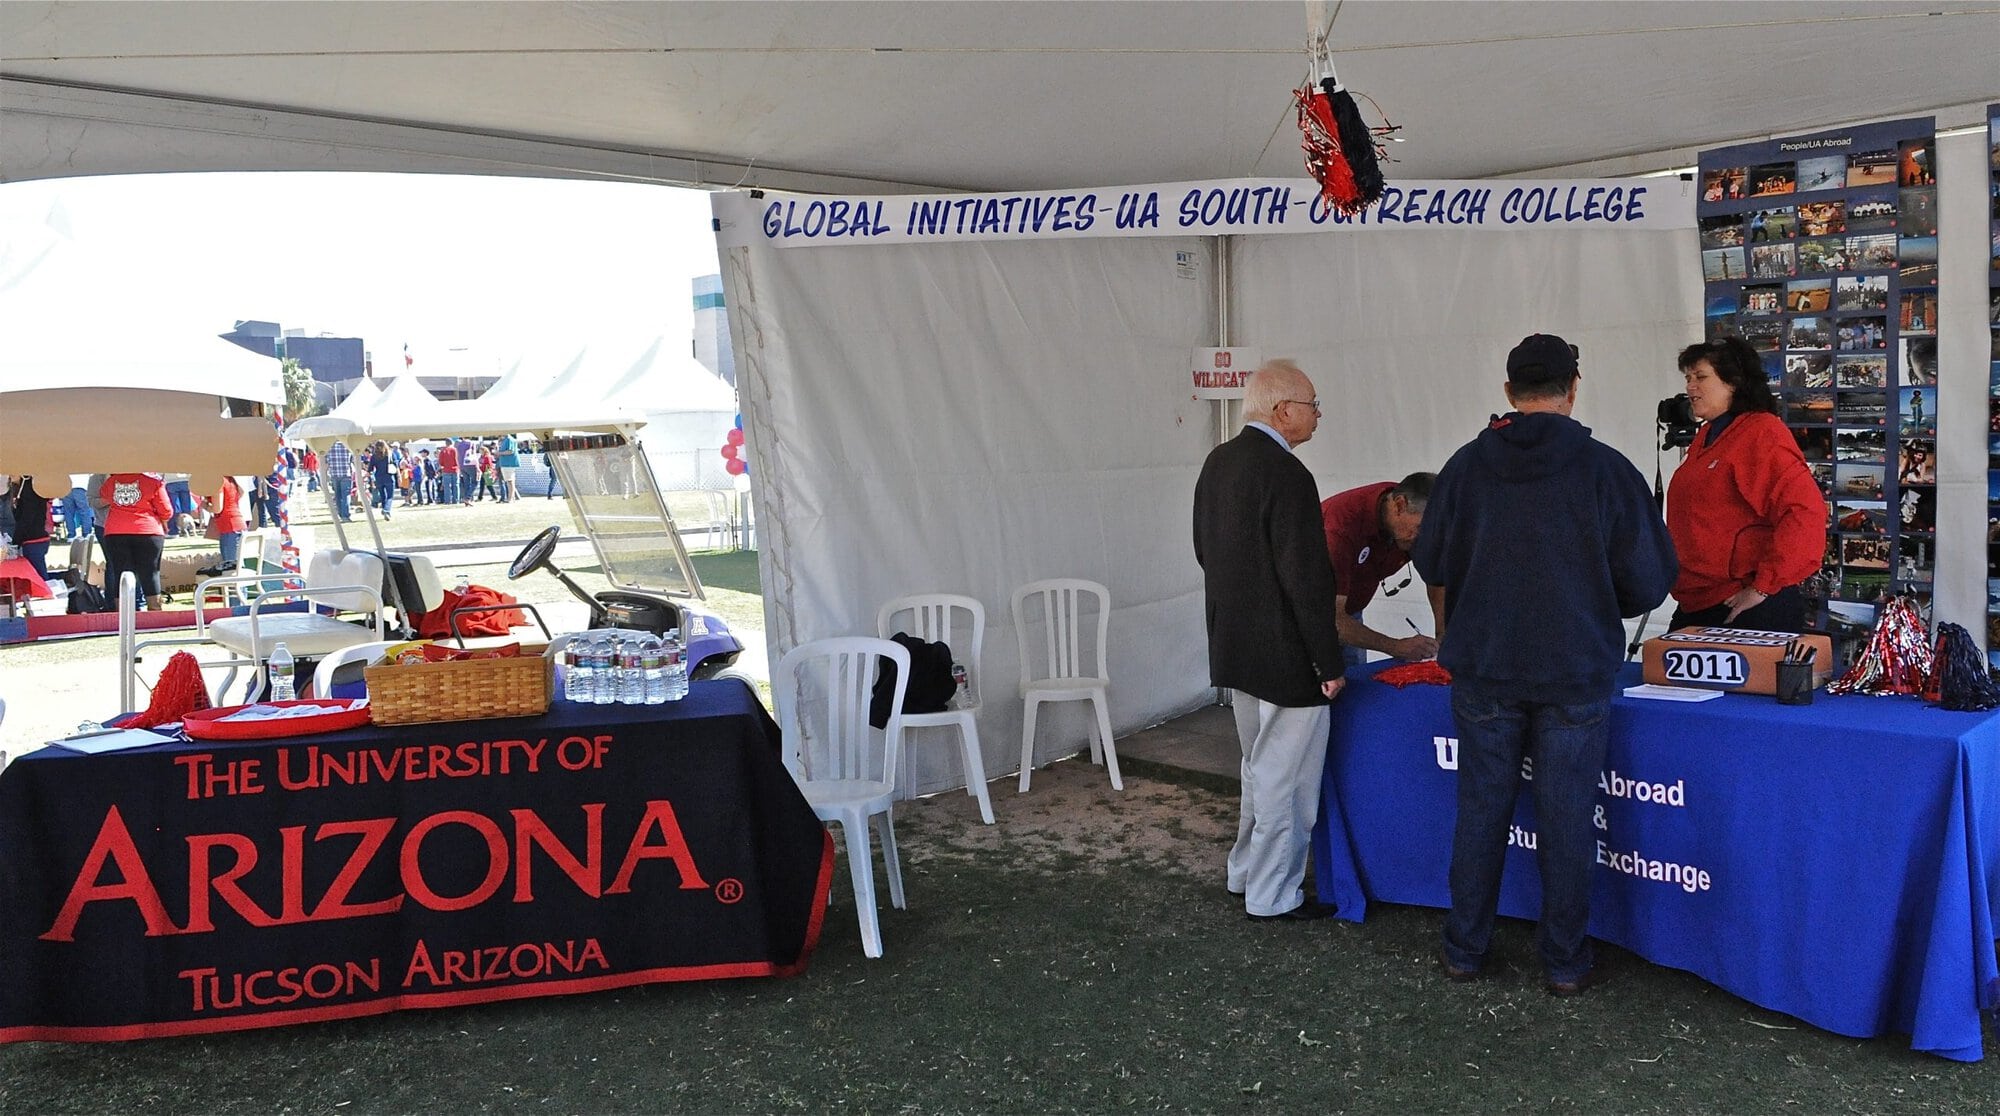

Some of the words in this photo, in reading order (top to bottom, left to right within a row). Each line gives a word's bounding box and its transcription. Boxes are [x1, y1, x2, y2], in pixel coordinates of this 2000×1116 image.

[1780, 140, 1821, 151] People/UA
[1823, 137, 1852, 147] Abroad
[762, 200, 890, 239] GLOBAL
[1501, 187, 1648, 223] COLLEGE
[1214, 351, 1232, 368] GO
[1192, 370, 1253, 388] WILDCAT
[1668, 652, 1742, 681] 2011
[556, 735, 613, 771] OF
[1598, 770, 1685, 807] Abroad
[1593, 804, 1608, 831] &
[39, 800, 709, 943] ARIZONA
[1596, 839, 1712, 893] Exchange
[179, 960, 382, 1012] TUCSON
[402, 939, 609, 990] ARIZONA
